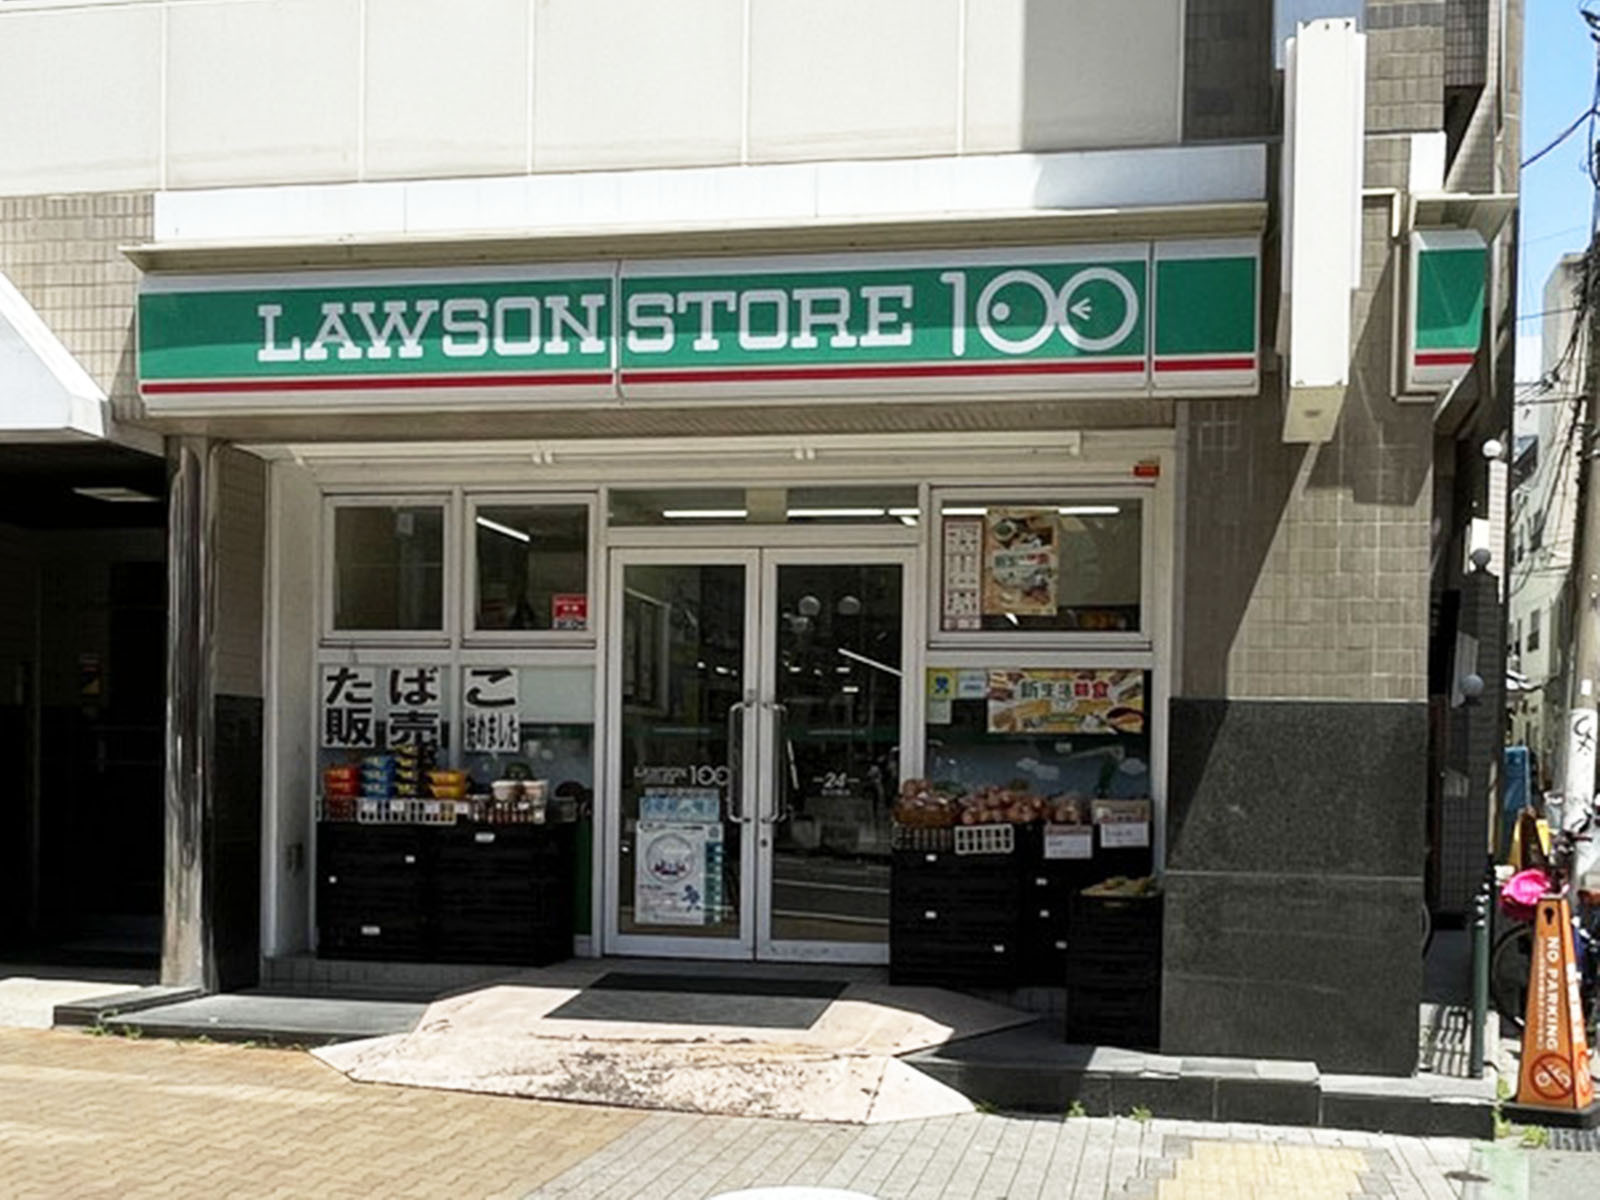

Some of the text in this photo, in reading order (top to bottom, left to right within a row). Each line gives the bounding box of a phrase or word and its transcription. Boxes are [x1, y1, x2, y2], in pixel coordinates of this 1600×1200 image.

[258, 268, 1139, 361] LAWSON STORE 100
[326, 667, 516, 709] たばこ
[1545, 936, 1560, 1050] NO PARKING
